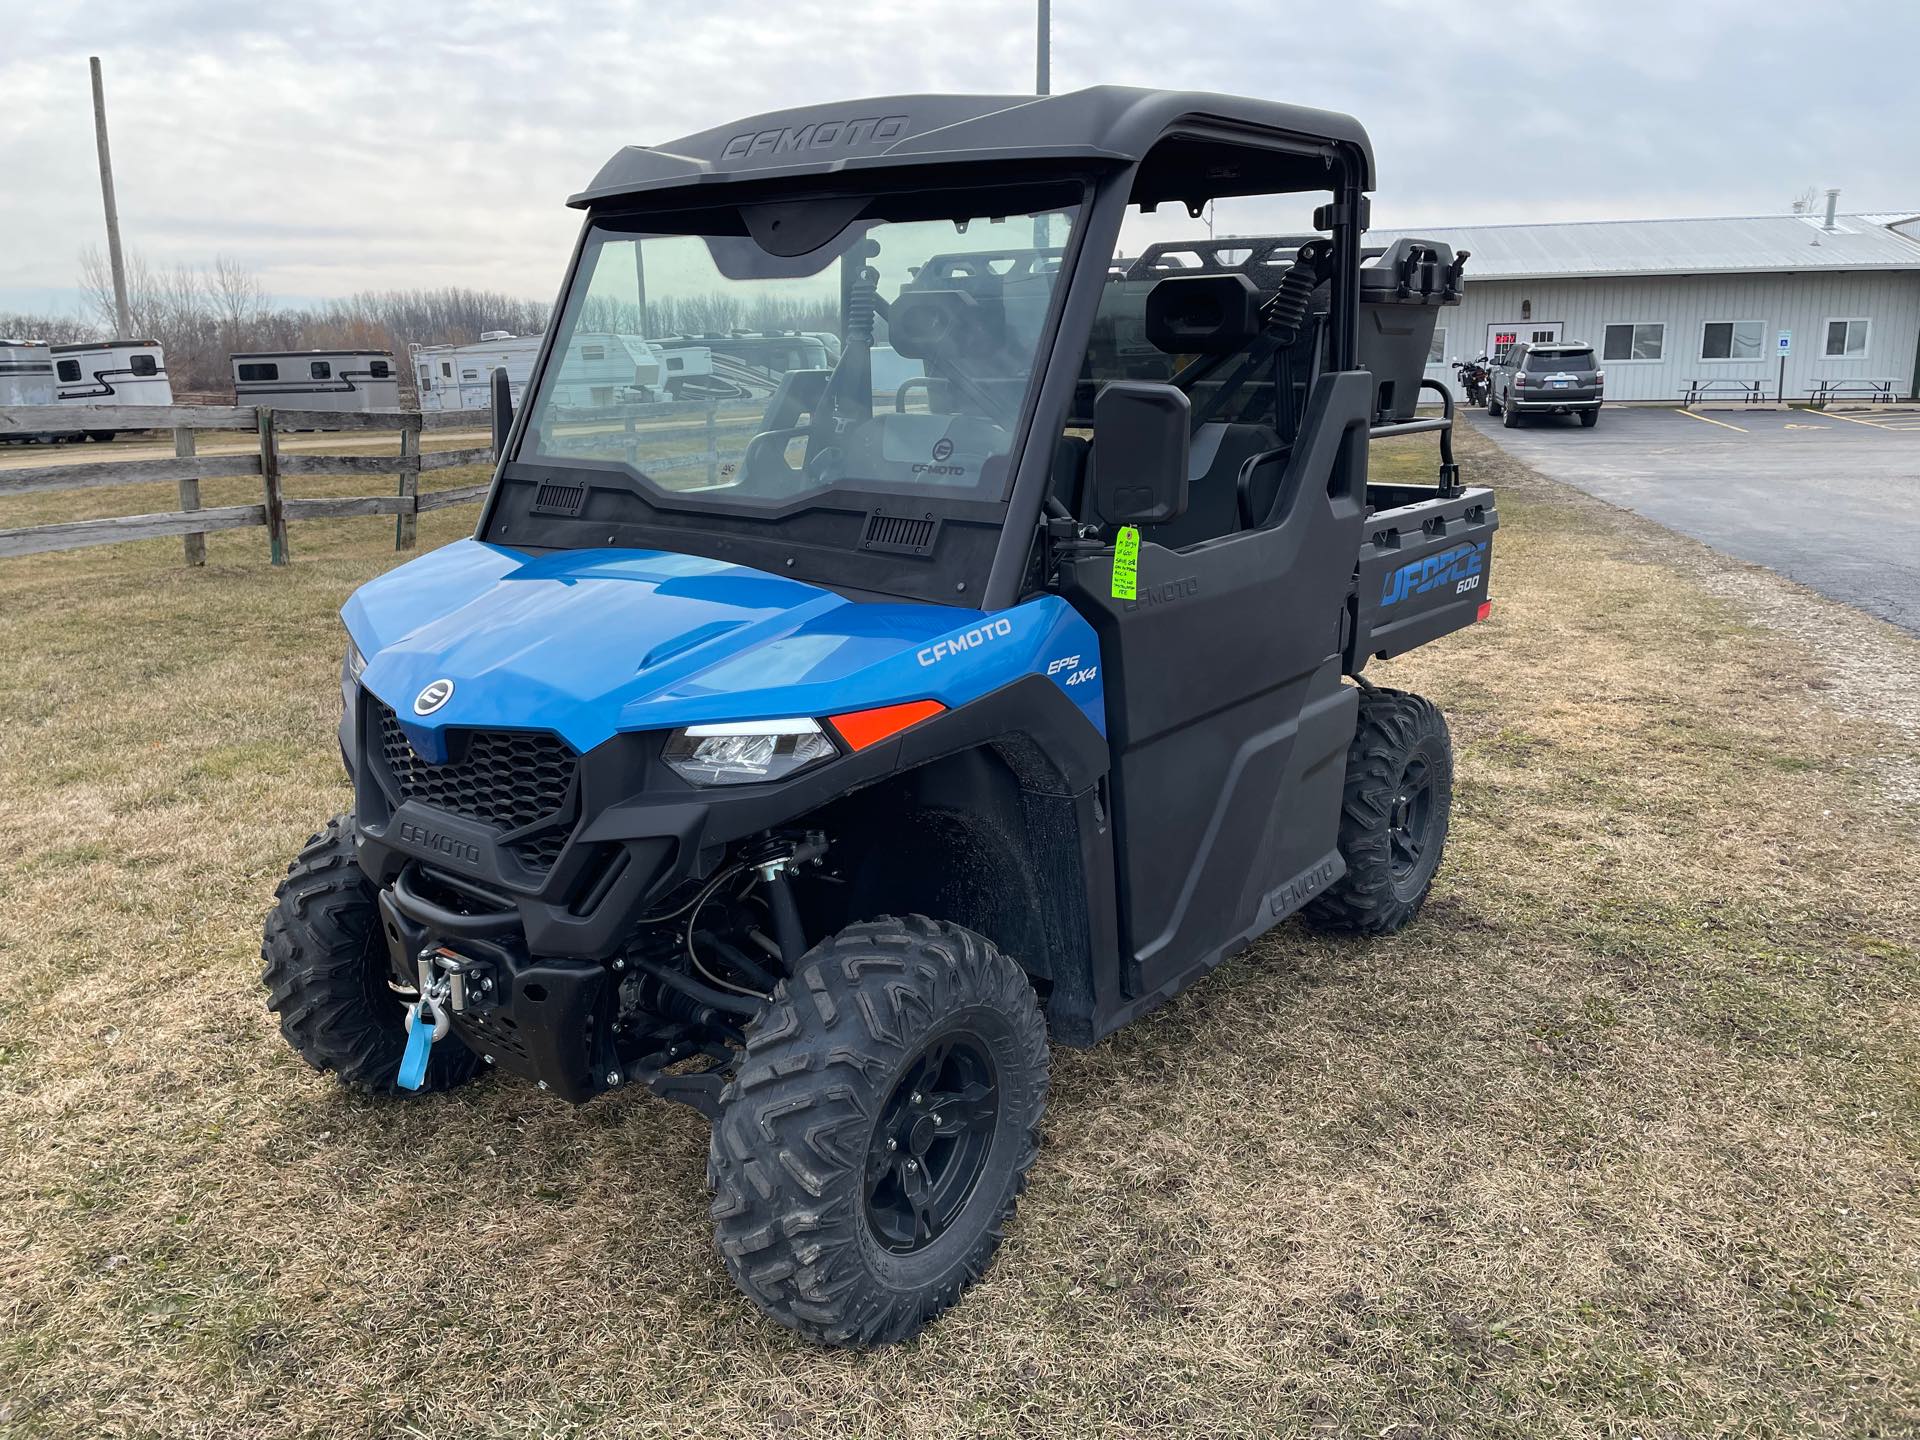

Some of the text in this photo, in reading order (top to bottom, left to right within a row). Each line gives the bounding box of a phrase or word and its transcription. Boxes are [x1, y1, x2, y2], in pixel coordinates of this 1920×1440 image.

[721, 115, 910, 161] CFMOTO
[911, 464, 965, 476] CFMOTO
[1380, 541, 1487, 607] UFORCE
[1456, 575, 1480, 594] 600
[916, 618, 1012, 667] CFMOTO
[1047, 655, 1081, 675] EPS
[400, 822, 480, 865] CFMOTO
[1269, 861, 1333, 917] CFMOTO
